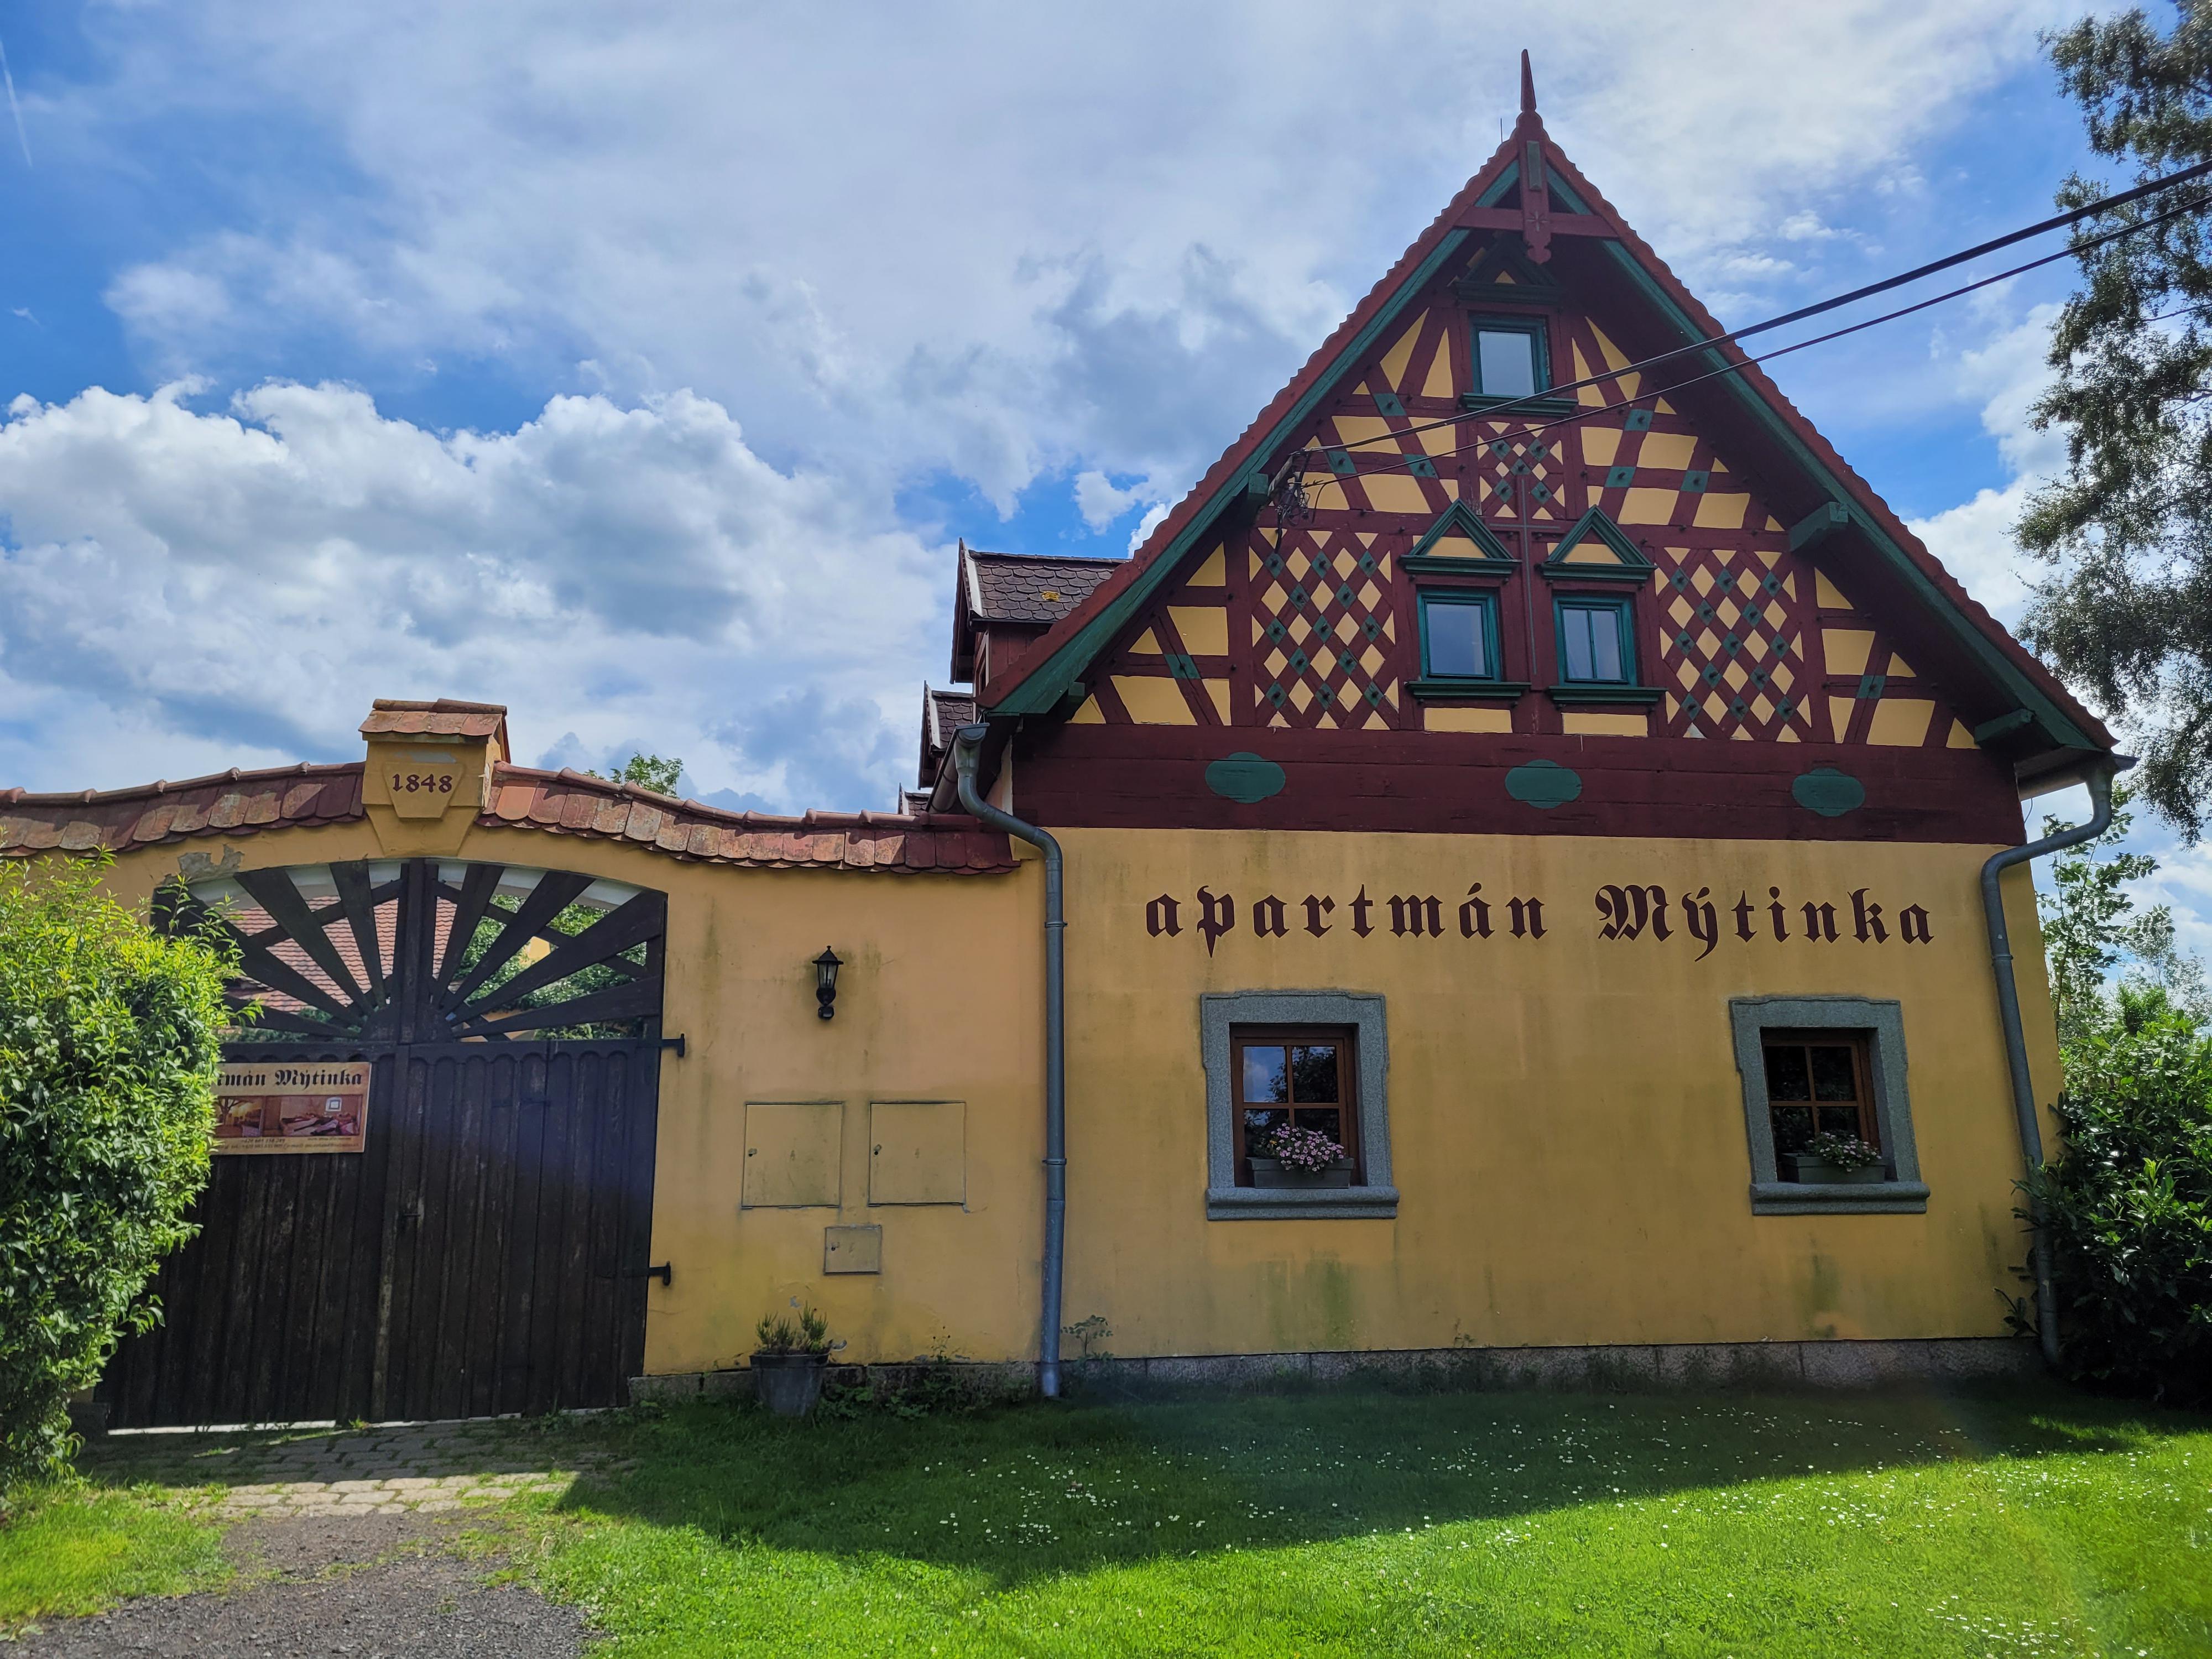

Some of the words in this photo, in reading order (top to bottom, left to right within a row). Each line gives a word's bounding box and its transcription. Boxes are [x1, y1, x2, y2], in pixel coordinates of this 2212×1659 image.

[392, 774, 453, 793] 1848
[1146, 883, 1548, 958] apartmán
[1595, 884, 1934, 962] Mýtinka
[275, 1069, 362, 1090] Mýtinka
